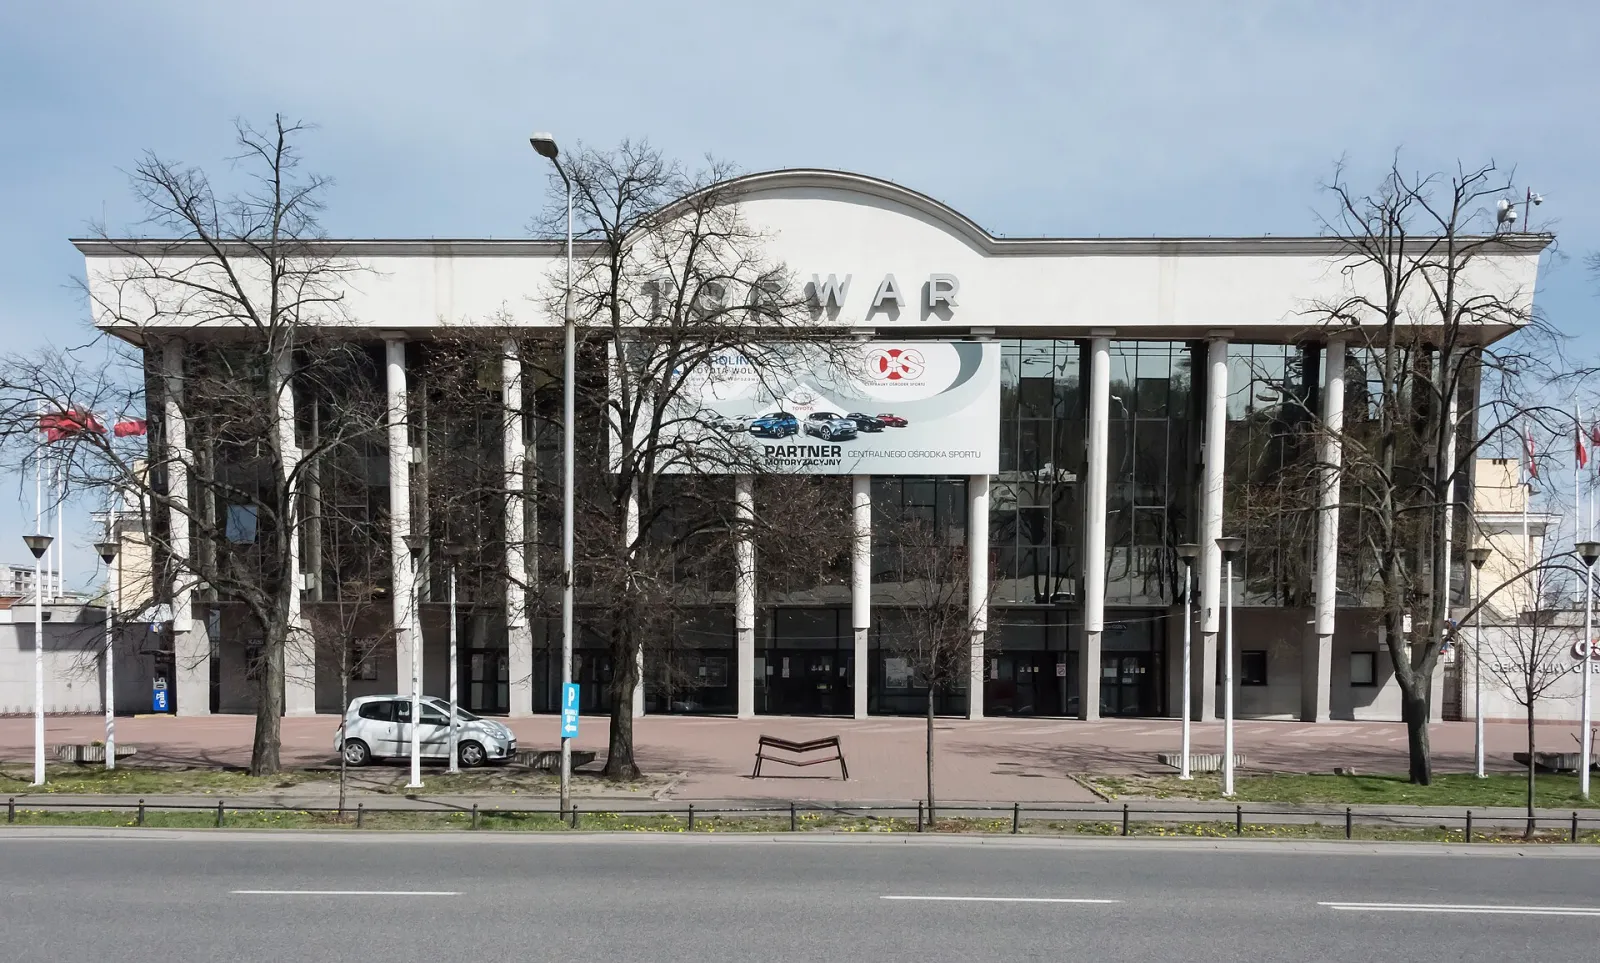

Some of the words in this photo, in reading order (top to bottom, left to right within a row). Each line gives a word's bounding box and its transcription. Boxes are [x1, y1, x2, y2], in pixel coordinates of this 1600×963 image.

[765, 445, 842, 458] PARTNER
[847, 450, 907, 458] CENTRALNEGO
[908, 448, 947, 458] OŚRODKA
[948, 450, 981, 459] SPORTU
[568, 686, 575, 707] P
